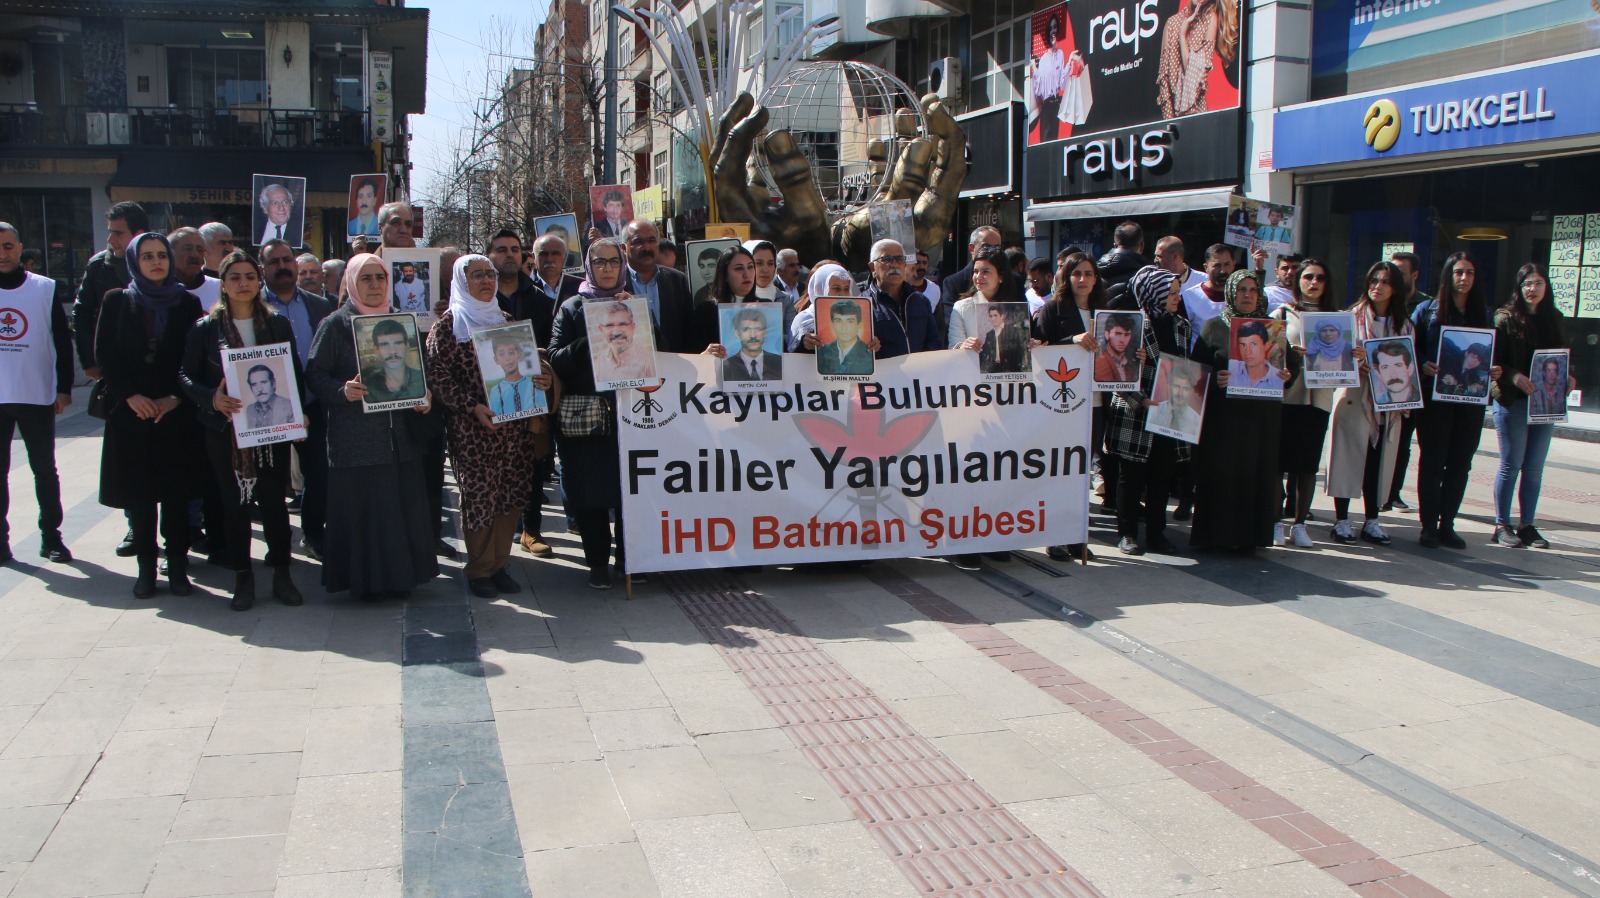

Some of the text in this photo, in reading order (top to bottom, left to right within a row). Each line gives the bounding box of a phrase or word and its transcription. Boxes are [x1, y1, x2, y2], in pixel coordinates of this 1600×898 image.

[1089, 0, 1159, 55] rays
[1354, 0, 1441, 26] intern
[1410, 87, 1555, 135] TURKCELL
[1063, 130, 1165, 181] rays
[228, 346, 289, 362] İBRAHİM ÇELİK
[368, 400, 425, 411] MAHMUT DEMİREL
[608, 379, 646, 388] TAHİR ELÇİ
[678, 378, 1037, 423] Kayıplar Bulunsun
[633, 422, 656, 430] HAKLARI
[628, 442, 1087, 498] Failler Yargılansın
[661, 501, 1046, 555] İHD Batman Şubesi
